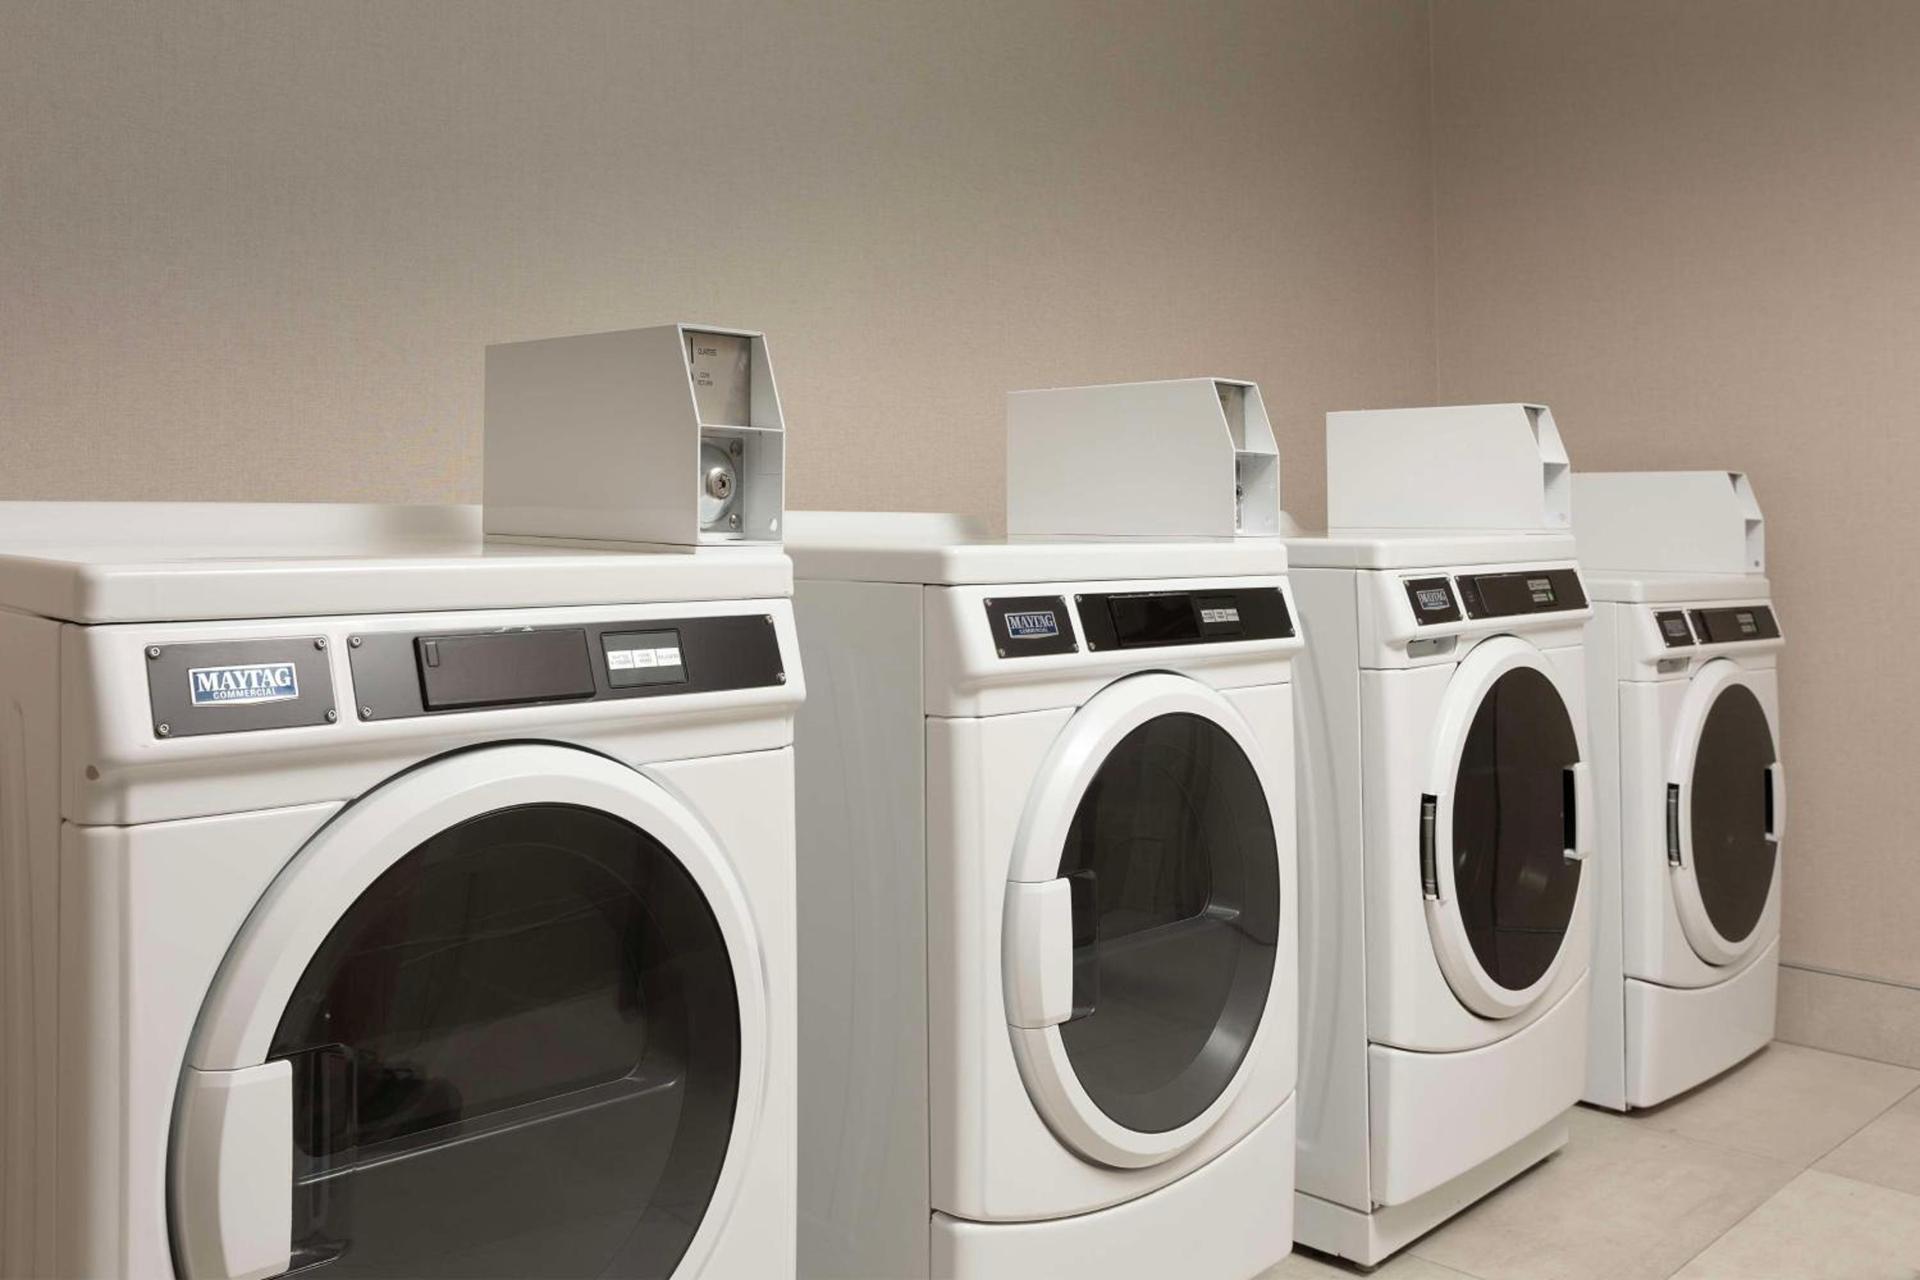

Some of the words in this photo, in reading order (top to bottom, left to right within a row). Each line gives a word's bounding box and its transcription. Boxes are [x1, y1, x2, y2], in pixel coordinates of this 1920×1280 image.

[1009, 615, 1053, 629] MAYTAG
[196, 668, 291, 692] MAYTAG
[213, 687, 276, 700] COMMERCIAL
